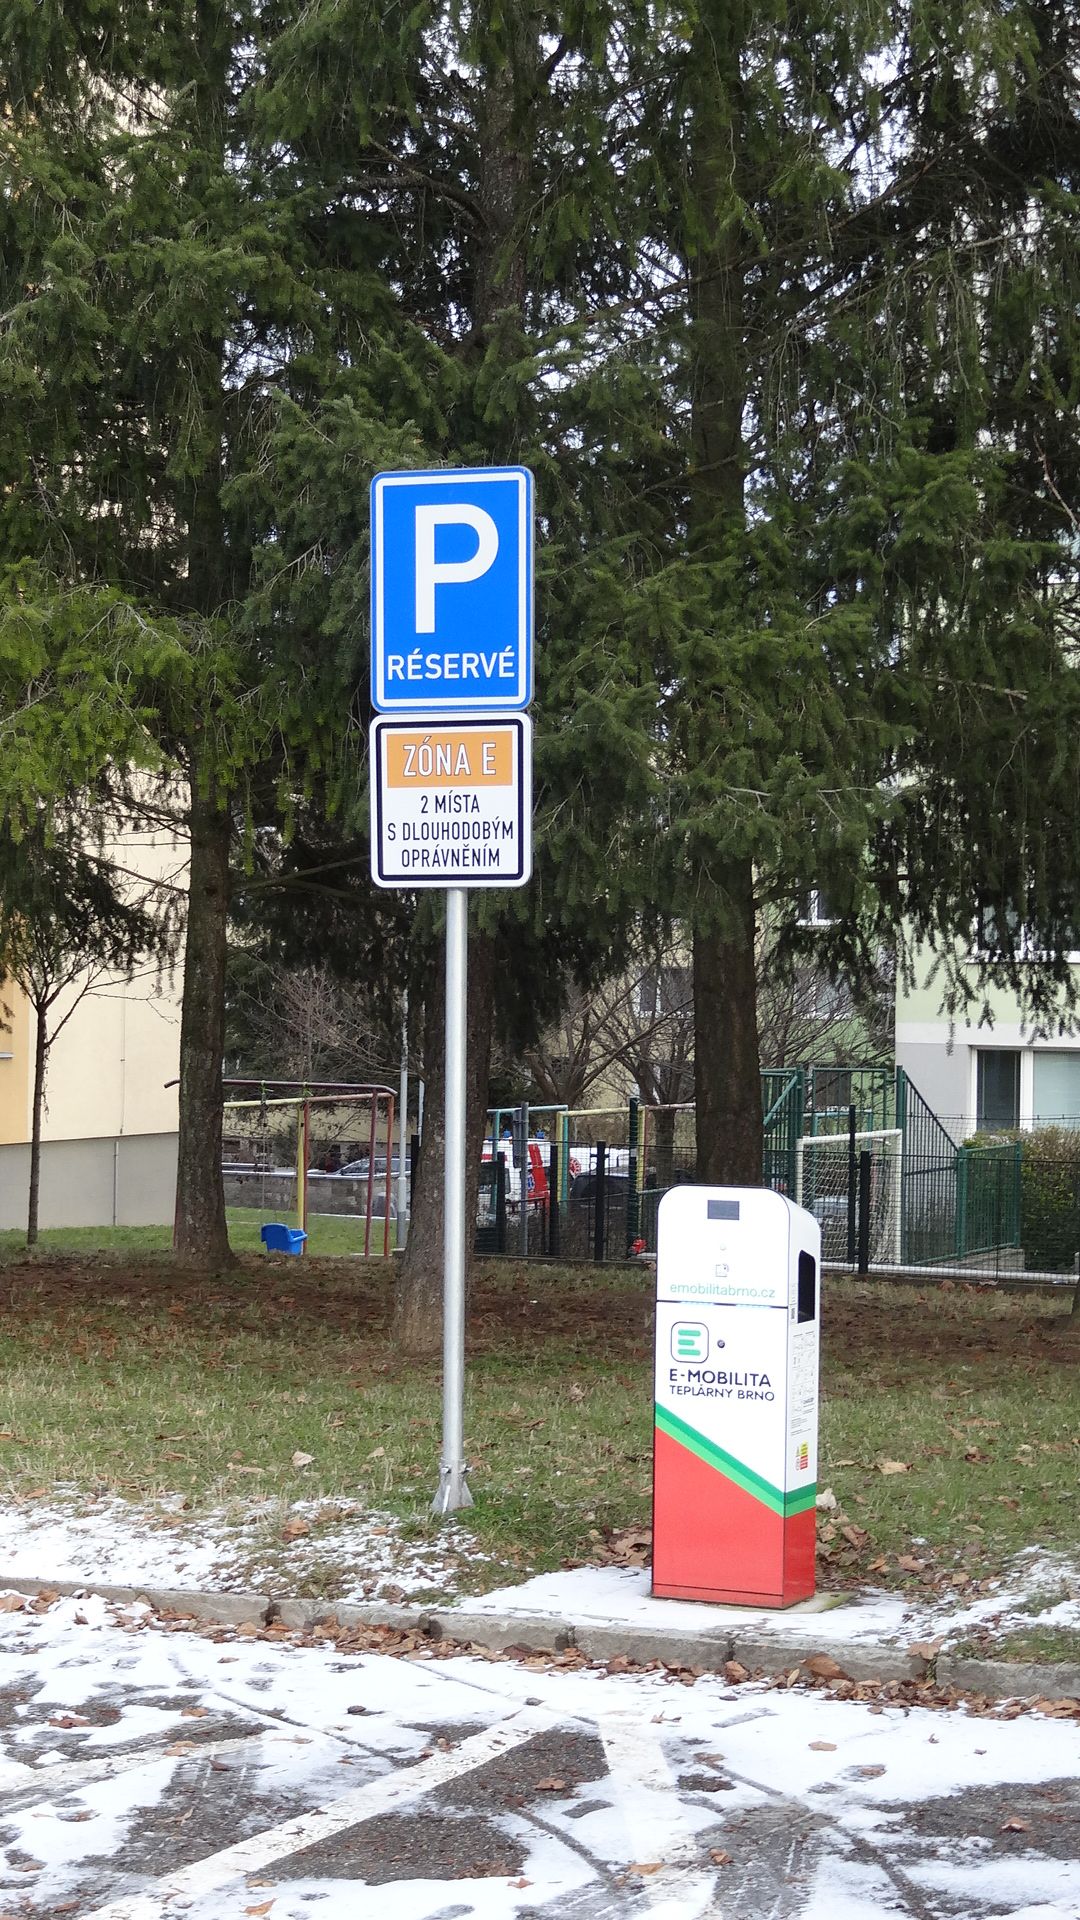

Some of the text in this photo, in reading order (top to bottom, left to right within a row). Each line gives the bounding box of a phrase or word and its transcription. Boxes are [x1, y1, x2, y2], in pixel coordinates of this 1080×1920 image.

[415, 503, 499, 633] P
[388, 646, 515, 680] RÉSERVÉ
[403, 736, 497, 777] ZÓNA E
[420, 791, 480, 814] 2 MÍSTA
[387, 816, 514, 841] S DLOUHODOBÝM
[401, 844, 501, 868] OPRÁVNĚNÍM
[670, 1283, 775, 1298] emobilitabrno.cz
[669, 1368, 771, 1387] E-MOBILITA
[669, 1384, 774, 1401] TEPLÁRNY BRNO
